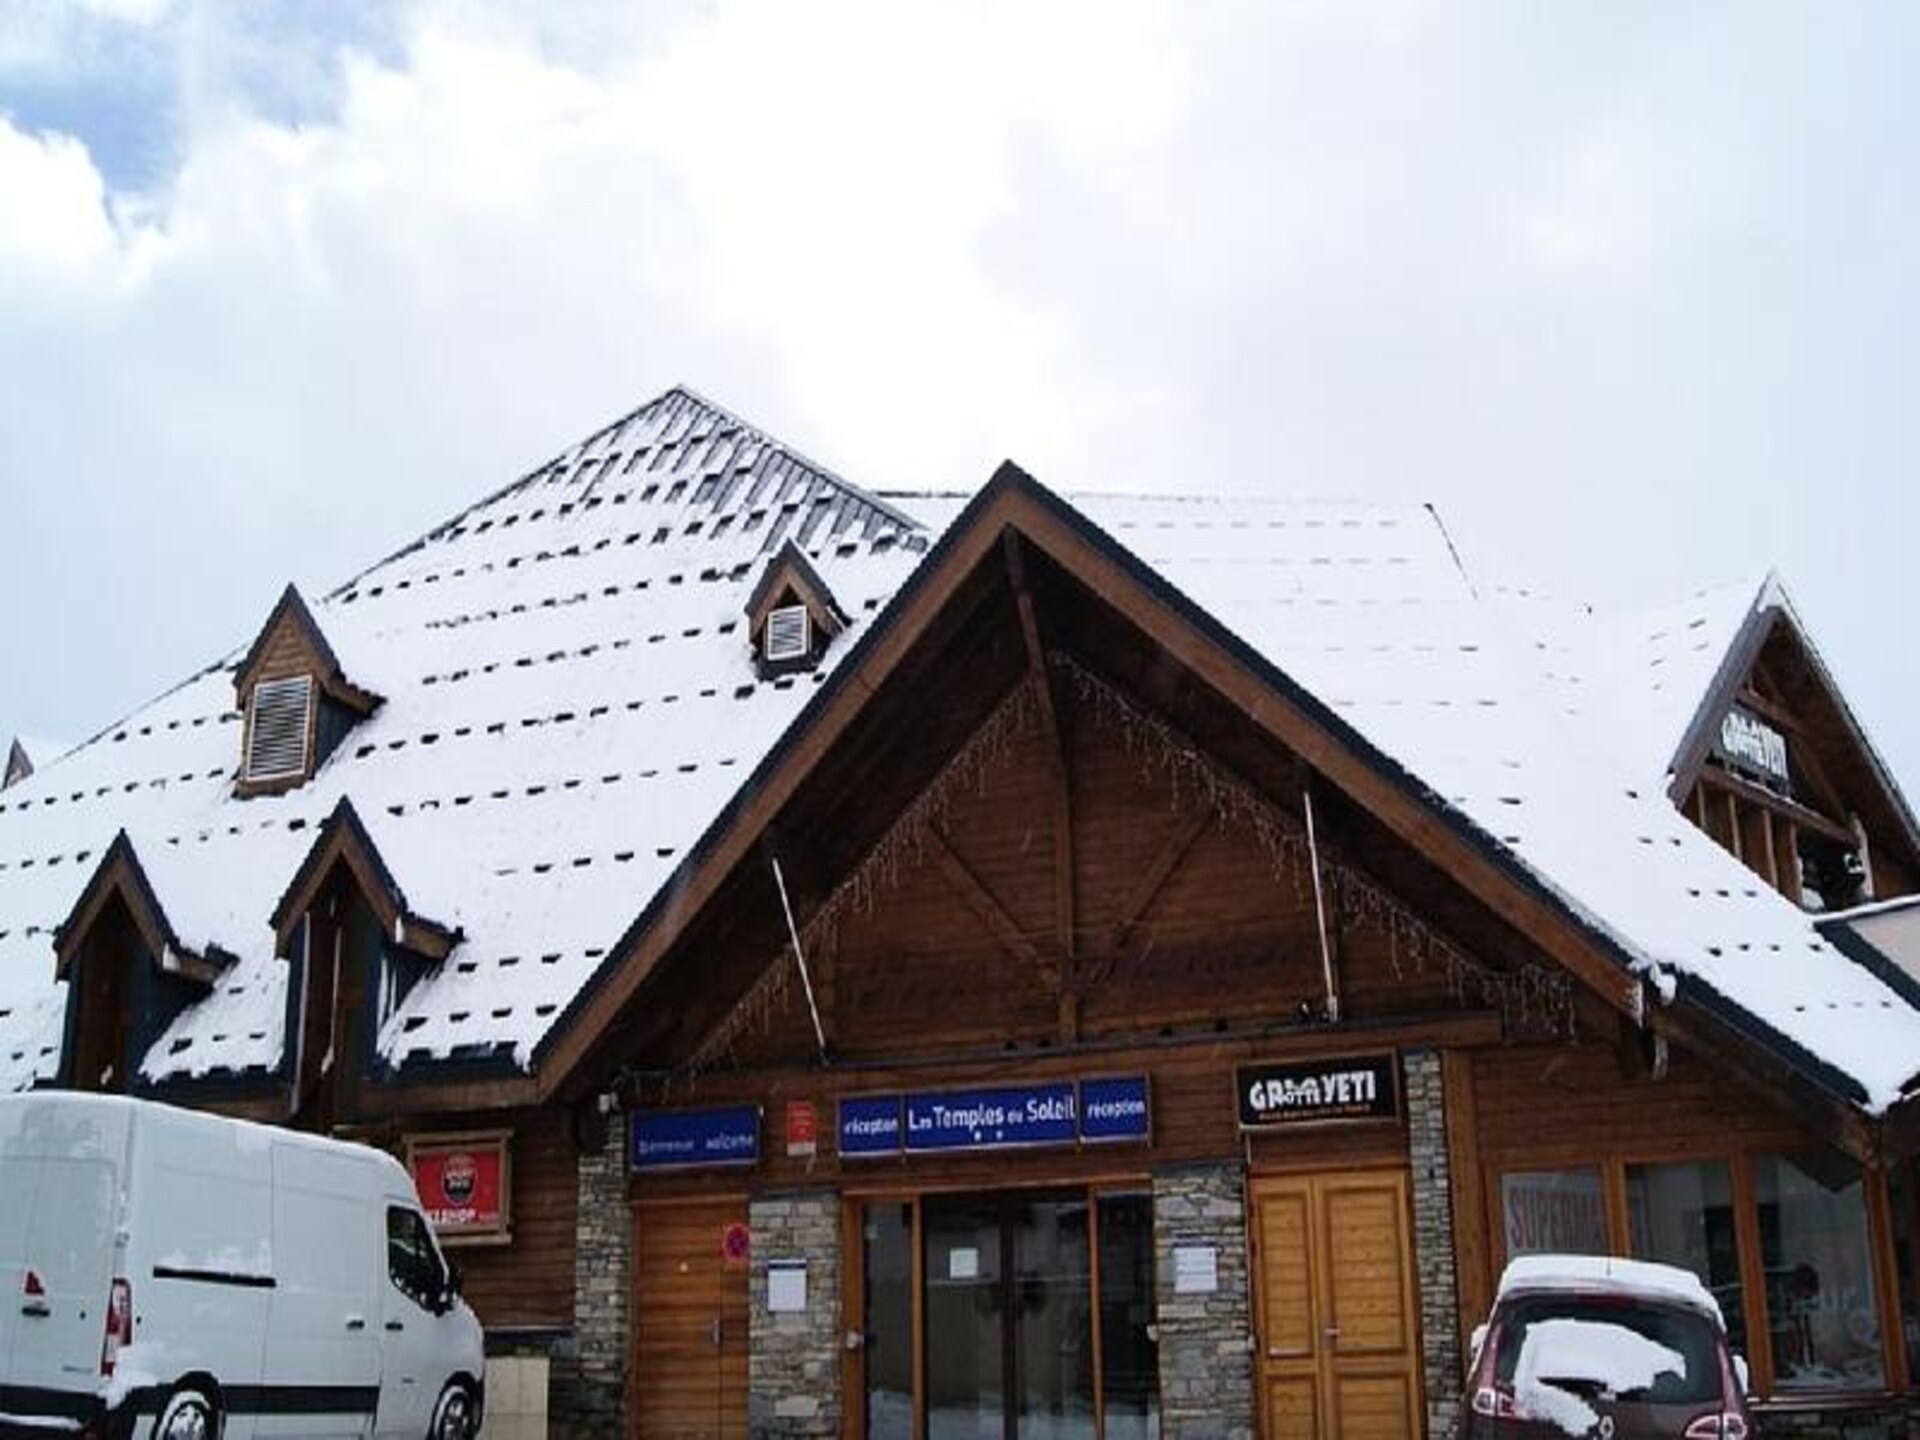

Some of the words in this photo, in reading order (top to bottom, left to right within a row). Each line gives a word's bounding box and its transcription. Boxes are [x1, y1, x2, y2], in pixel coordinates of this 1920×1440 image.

[1321, 1071, 1375, 1104] YETI
[933, 1105, 1004, 1129] Temples
[1026, 1097, 1076, 1122] Soleil
